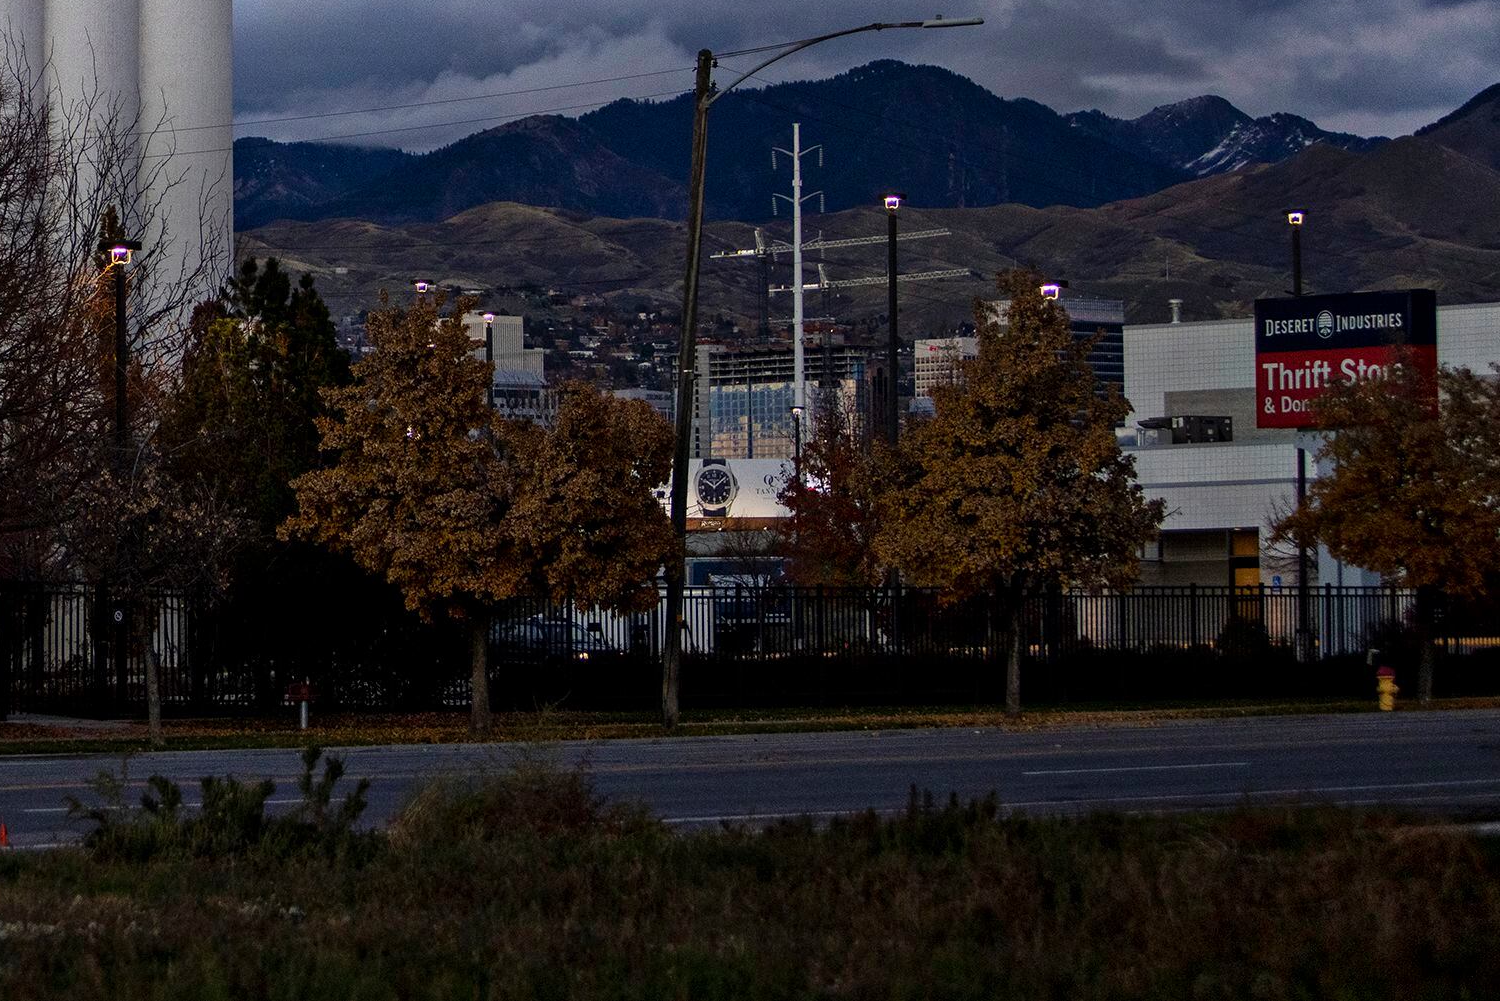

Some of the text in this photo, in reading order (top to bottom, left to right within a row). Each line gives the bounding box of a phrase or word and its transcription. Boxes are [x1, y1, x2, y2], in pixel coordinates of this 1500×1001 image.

[1265, 313, 1402, 337] DESERET INDUSTRIES
[1262, 360, 1331, 390] Thrift
[1264, 397, 1275, 414] &
